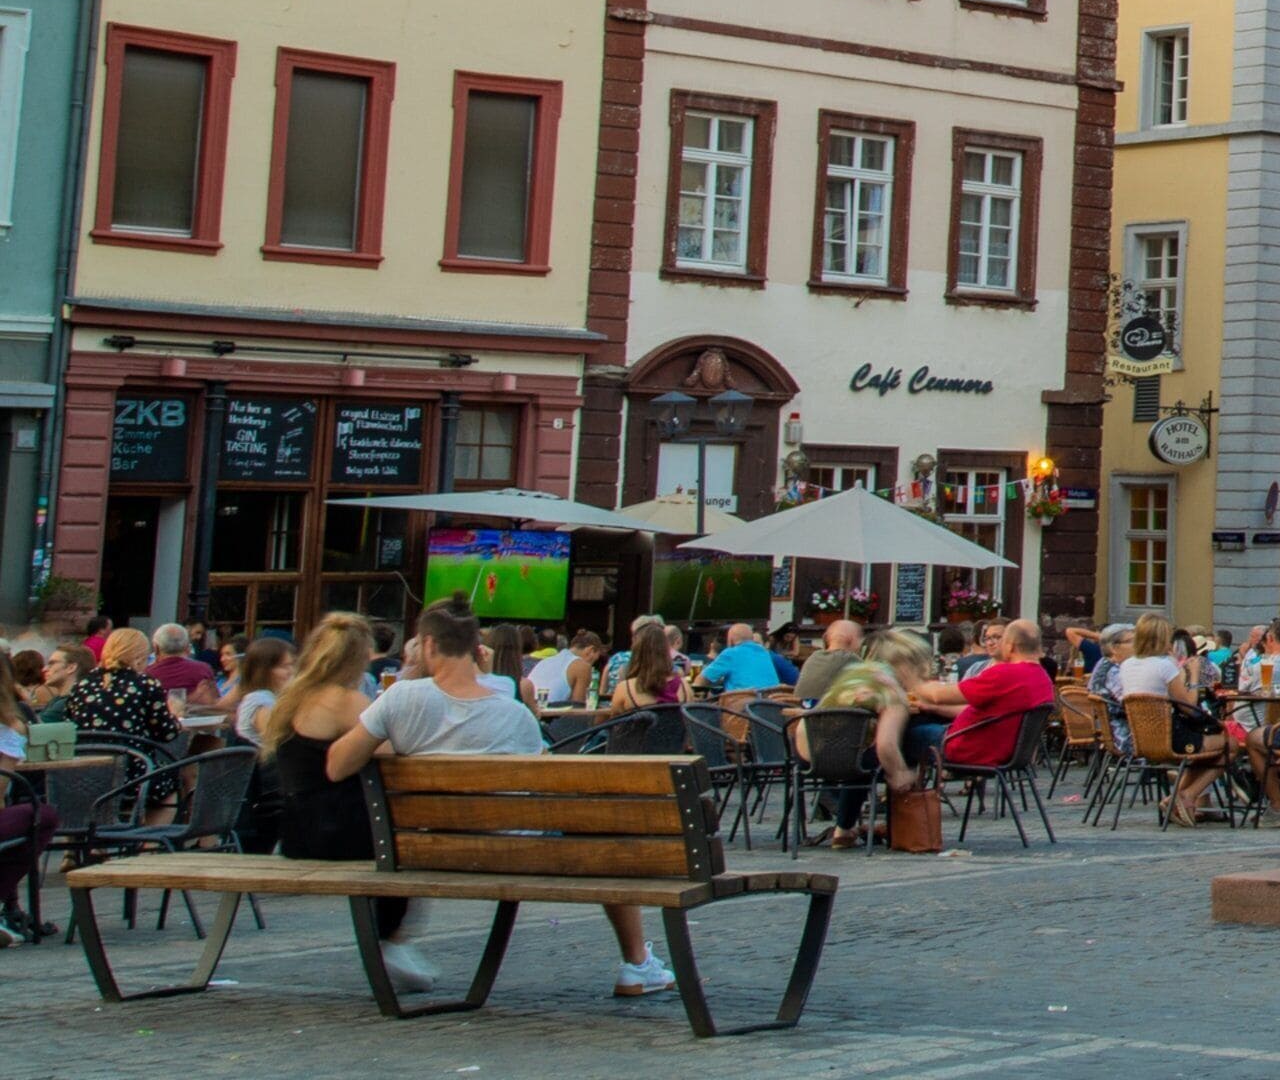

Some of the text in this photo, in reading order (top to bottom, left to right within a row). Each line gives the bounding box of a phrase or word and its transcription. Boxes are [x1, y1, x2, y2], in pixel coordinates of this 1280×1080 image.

[1111, 360, 1171, 374] Restaurant
[849, 362, 903, 398] Café
[114, 400, 187, 427] ZKB
[114, 427, 161, 440] Zimmer
[236, 429, 257, 443] GIN
[1166, 422, 1200, 437] HOTEL
[226, 440, 268, 456] TASTING
[1175, 437, 1190, 445] am
[1161, 442, 1203, 460] RATHAUS
[112, 457, 139, 471] Bar
